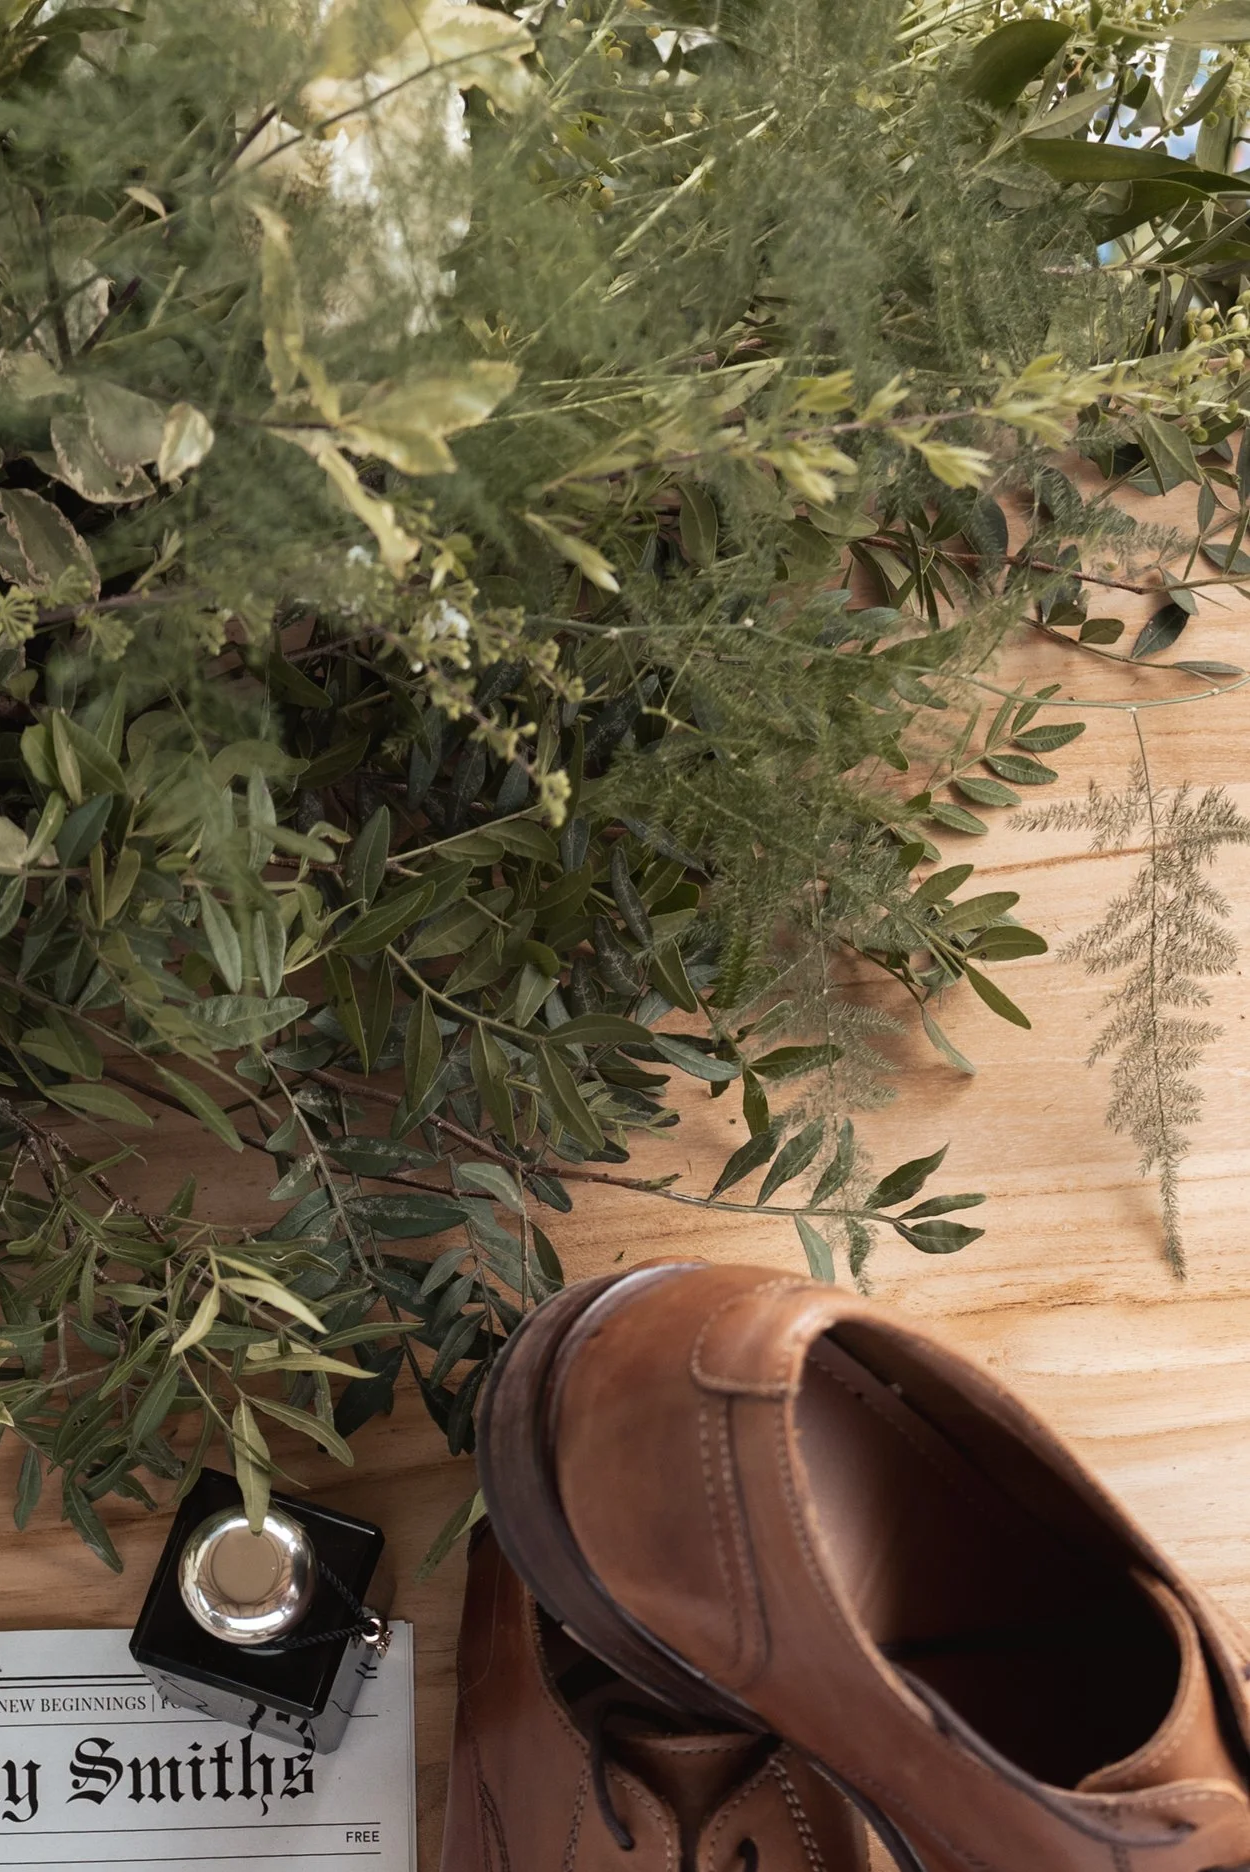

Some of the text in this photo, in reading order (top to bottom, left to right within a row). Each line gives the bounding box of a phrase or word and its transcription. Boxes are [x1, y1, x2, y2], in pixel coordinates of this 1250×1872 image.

[41, 1696, 146, 1712] BEGINNINGS
[67, 1735, 316, 1817] Smiths
[346, 1831, 379, 1842] FREE
